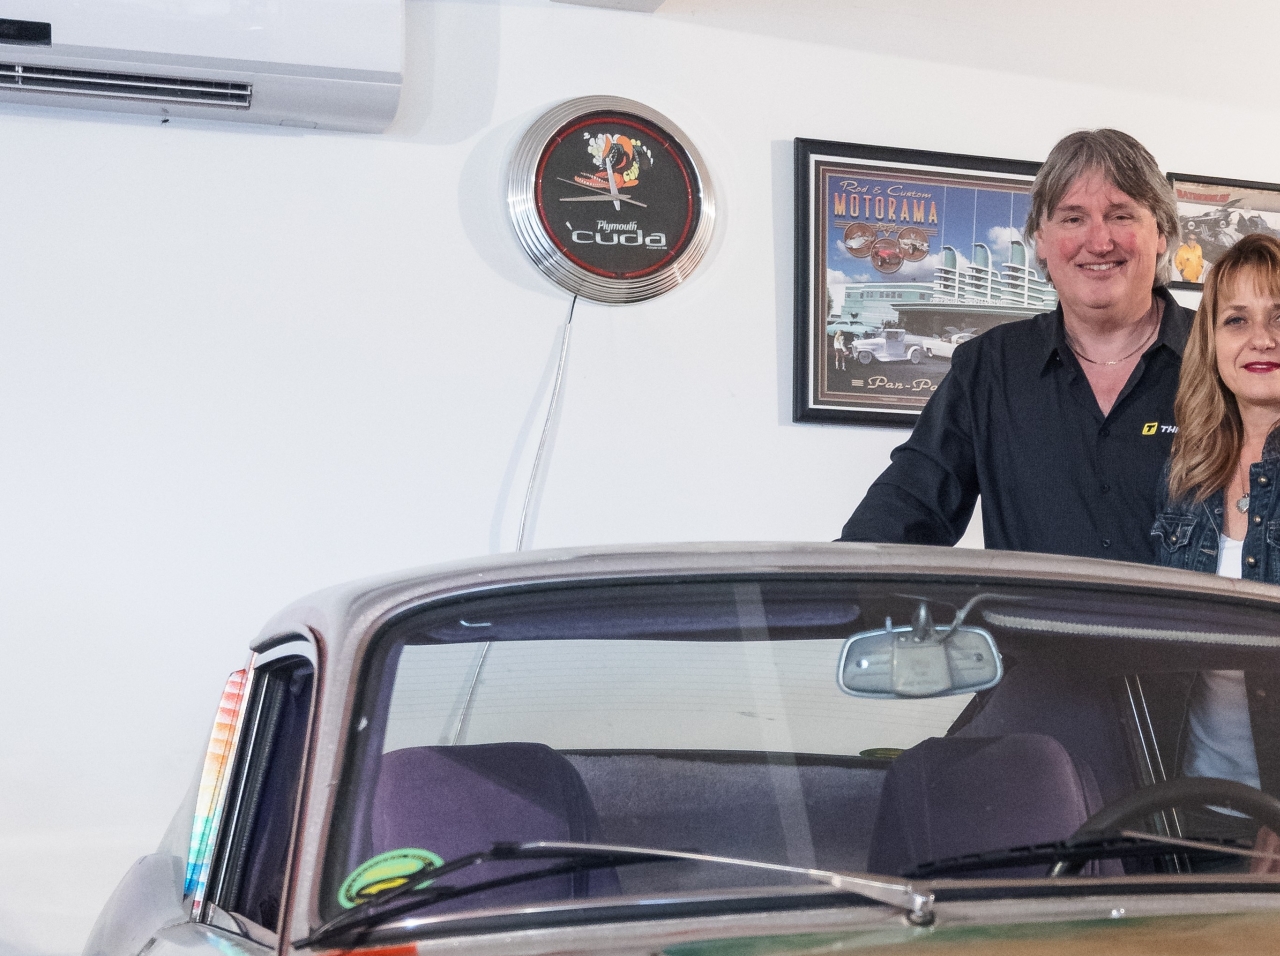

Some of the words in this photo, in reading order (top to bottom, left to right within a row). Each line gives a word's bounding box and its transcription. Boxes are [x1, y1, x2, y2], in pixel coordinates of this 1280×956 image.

[840, 180, 869, 193] Rod
[872, 186, 882, 194] &
[887, 185, 932, 199] Custom
[834, 192, 938, 224] MOTORAMA
[596, 220, 638, 233] Plymouth
